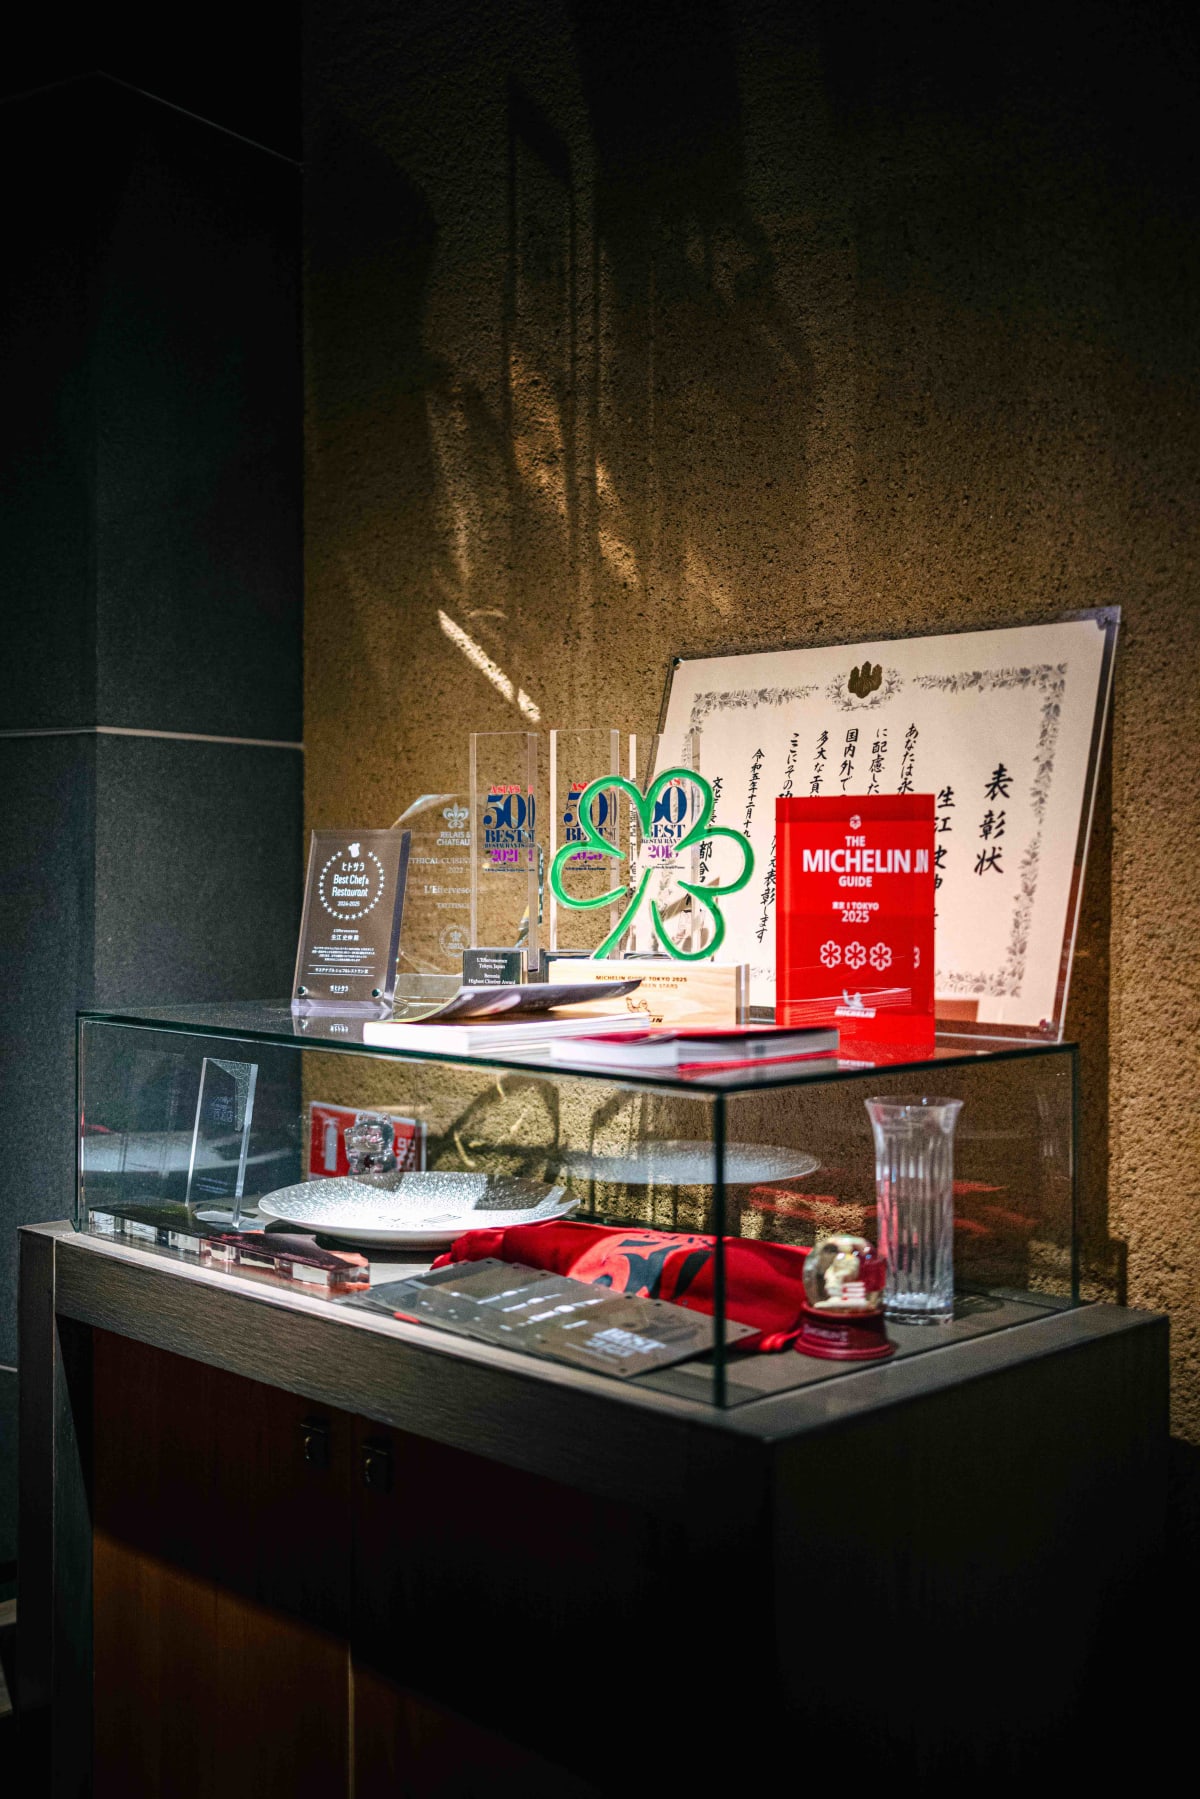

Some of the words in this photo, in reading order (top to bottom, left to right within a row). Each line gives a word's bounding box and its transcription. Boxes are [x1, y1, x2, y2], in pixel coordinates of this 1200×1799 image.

[809, 730, 829, 798] 多大な貢
[839, 728, 859, 797] 国内外で
[483, 793, 526, 829] 50
[974, 763, 1014, 876] 表彰状
[485, 829, 526, 843] BEST
[650, 824, 686, 838] EST
[845, 835, 866, 847] THE
[341, 862, 365, 872] ヒトサラ
[802, 849, 911, 873] MICHELIN
[333, 874, 349, 885] Best
[838, 876, 873, 887] GUIDE
[332, 886, 368, 897] Restaurant
[851, 902, 880, 911] TOKYO
[841, 910, 870, 923] 2025
